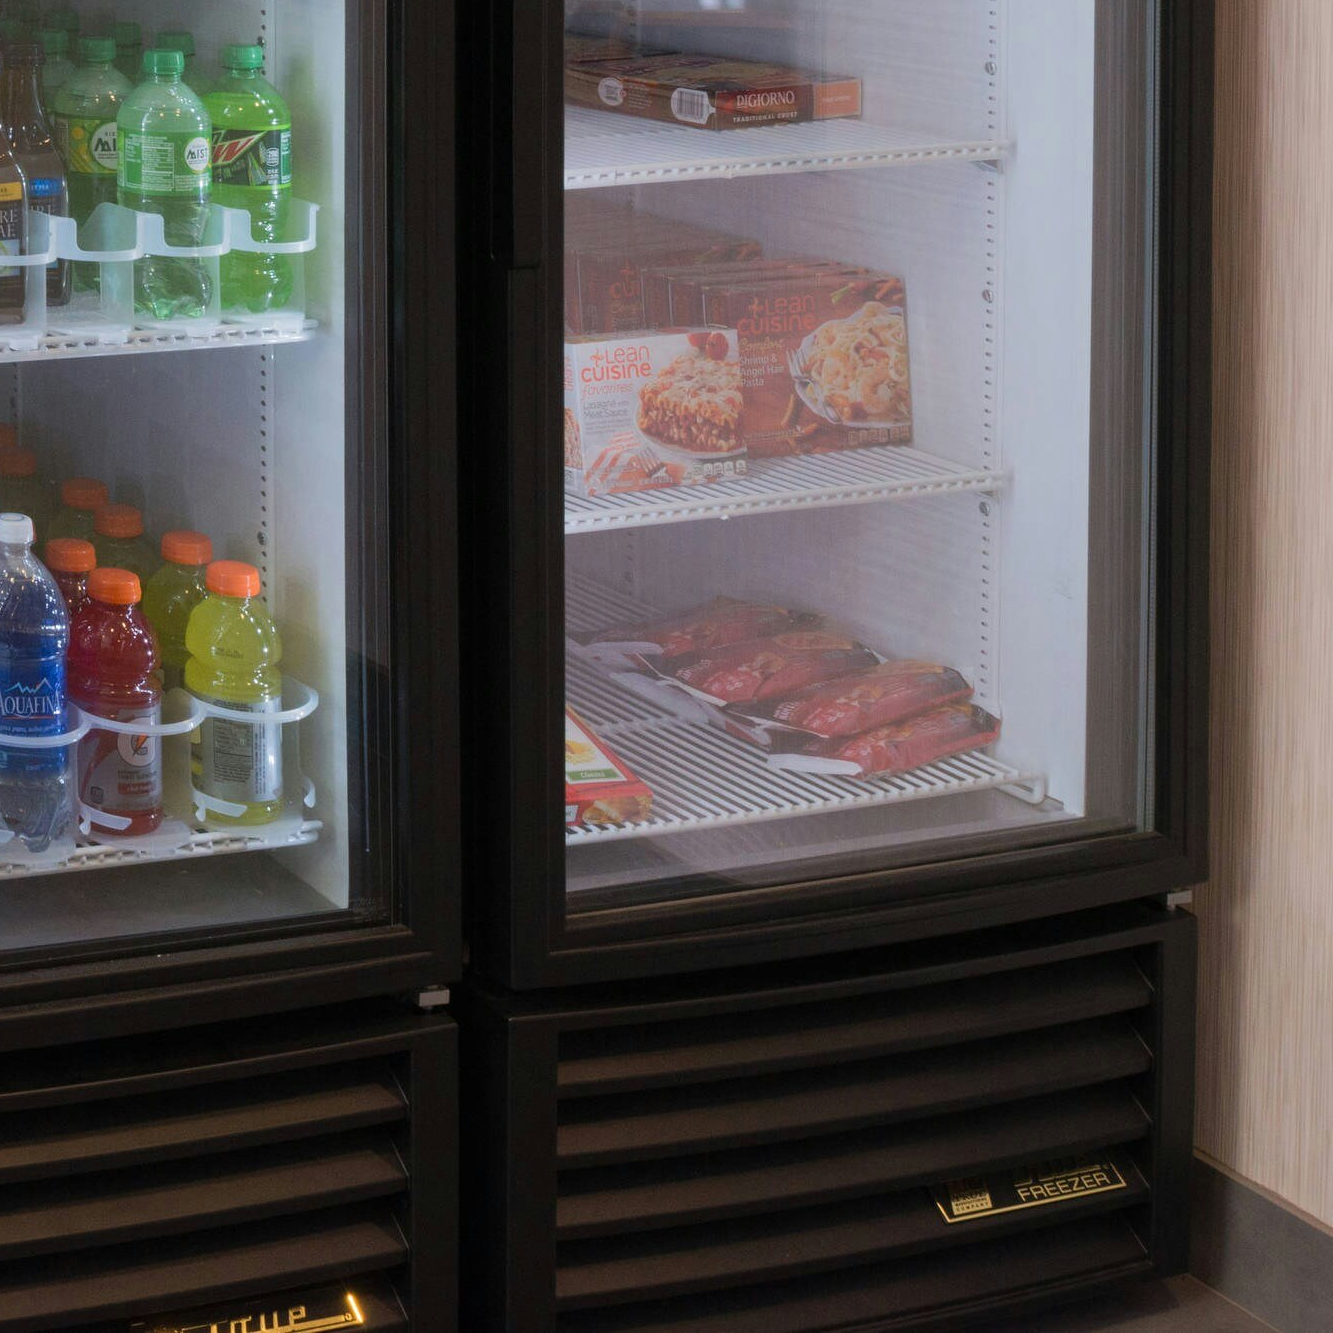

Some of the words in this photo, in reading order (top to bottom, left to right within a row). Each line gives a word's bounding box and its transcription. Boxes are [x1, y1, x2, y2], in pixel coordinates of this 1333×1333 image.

[764, 294, 816, 315] Lean
[736, 313, 817, 335] cuisine
[604, 344, 651, 364] Lean
[580, 362, 652, 383] cuisine
[1017, 1171, 1111, 1203] FREEZER
